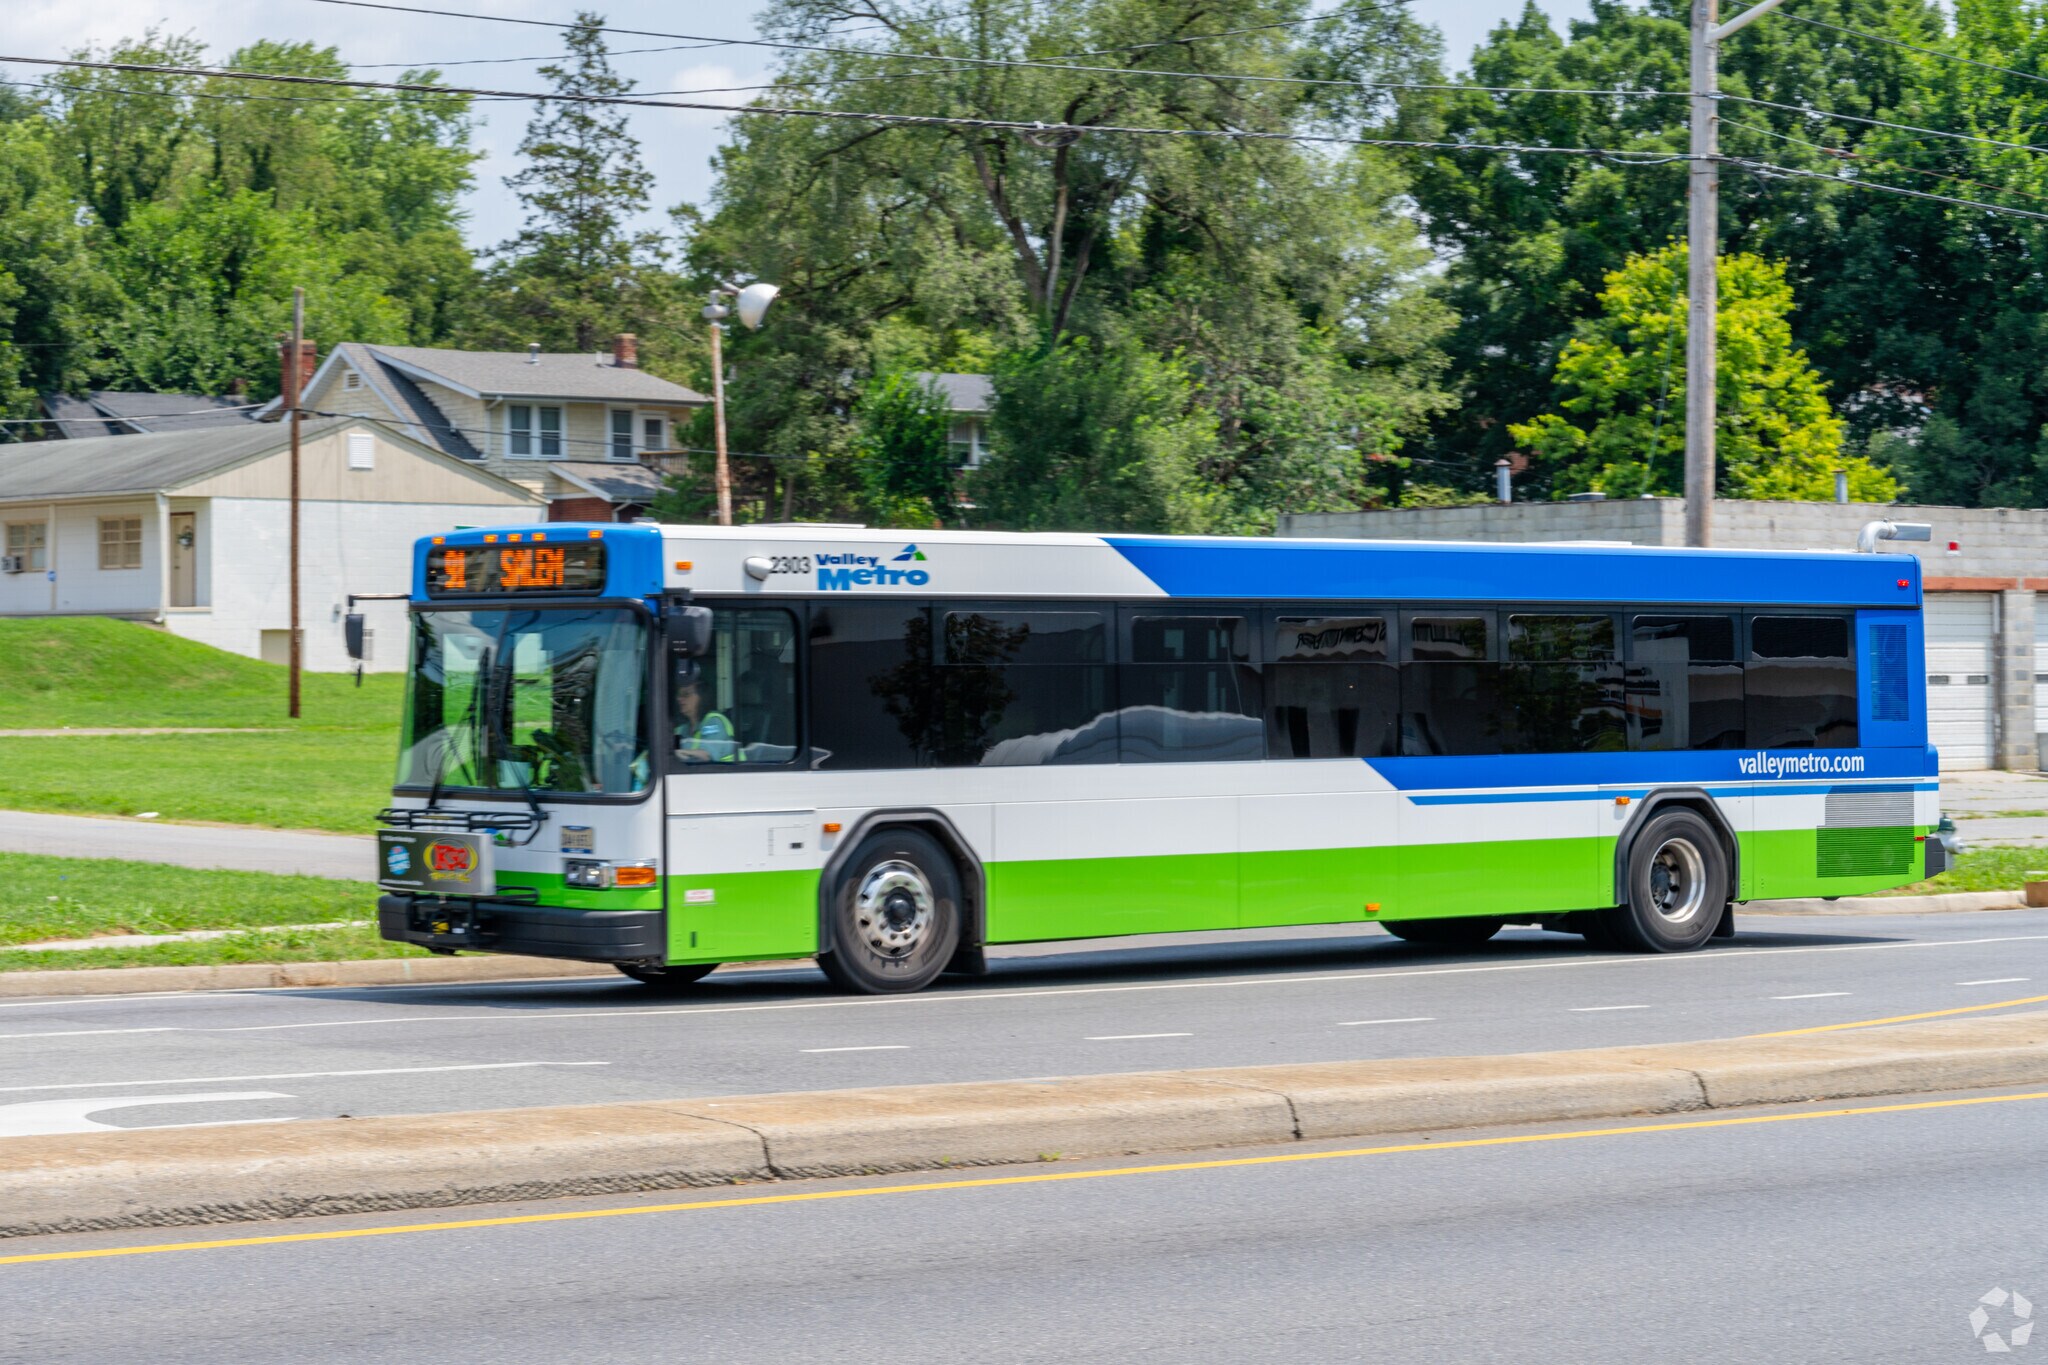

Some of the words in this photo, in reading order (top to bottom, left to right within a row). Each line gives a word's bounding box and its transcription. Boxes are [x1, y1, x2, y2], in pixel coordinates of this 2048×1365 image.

[501, 549, 564, 587] SALEM
[769, 556, 810, 573] 2303
[815, 553, 879, 567] Valley
[817, 565, 929, 591] Metro
[1739, 751, 1864, 778] valleymetro.com
